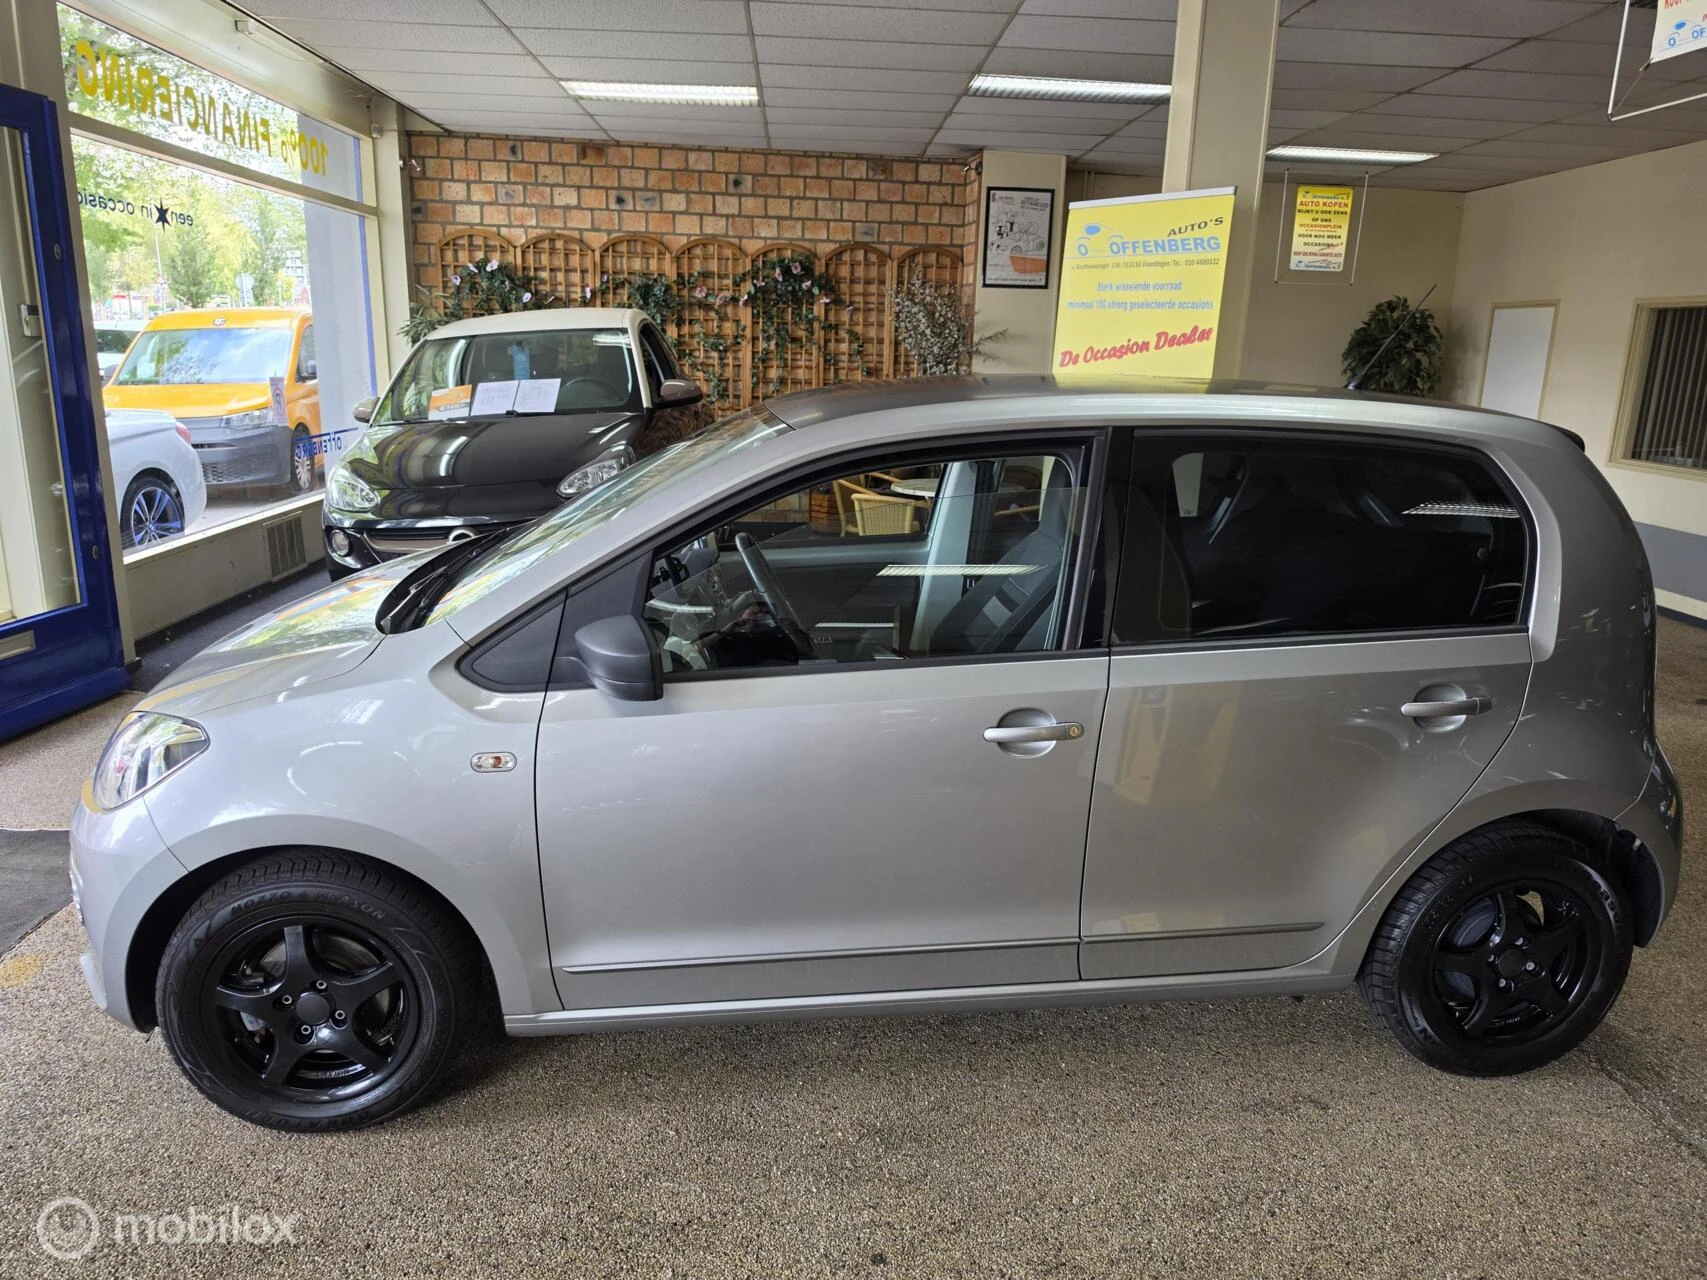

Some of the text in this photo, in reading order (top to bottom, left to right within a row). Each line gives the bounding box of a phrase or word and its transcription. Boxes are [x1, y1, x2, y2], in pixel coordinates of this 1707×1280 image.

[1167, 216, 1224, 237] AUTO'S
[1109, 236, 1221, 255] OFFENBERG
[1152, 280, 1182, 290] voorraad
[1129, 299, 1175, 311] geselecteerde
[1178, 300, 1213, 309] occasions
[1059, 325, 1213, 368] De Occasion Dealer
